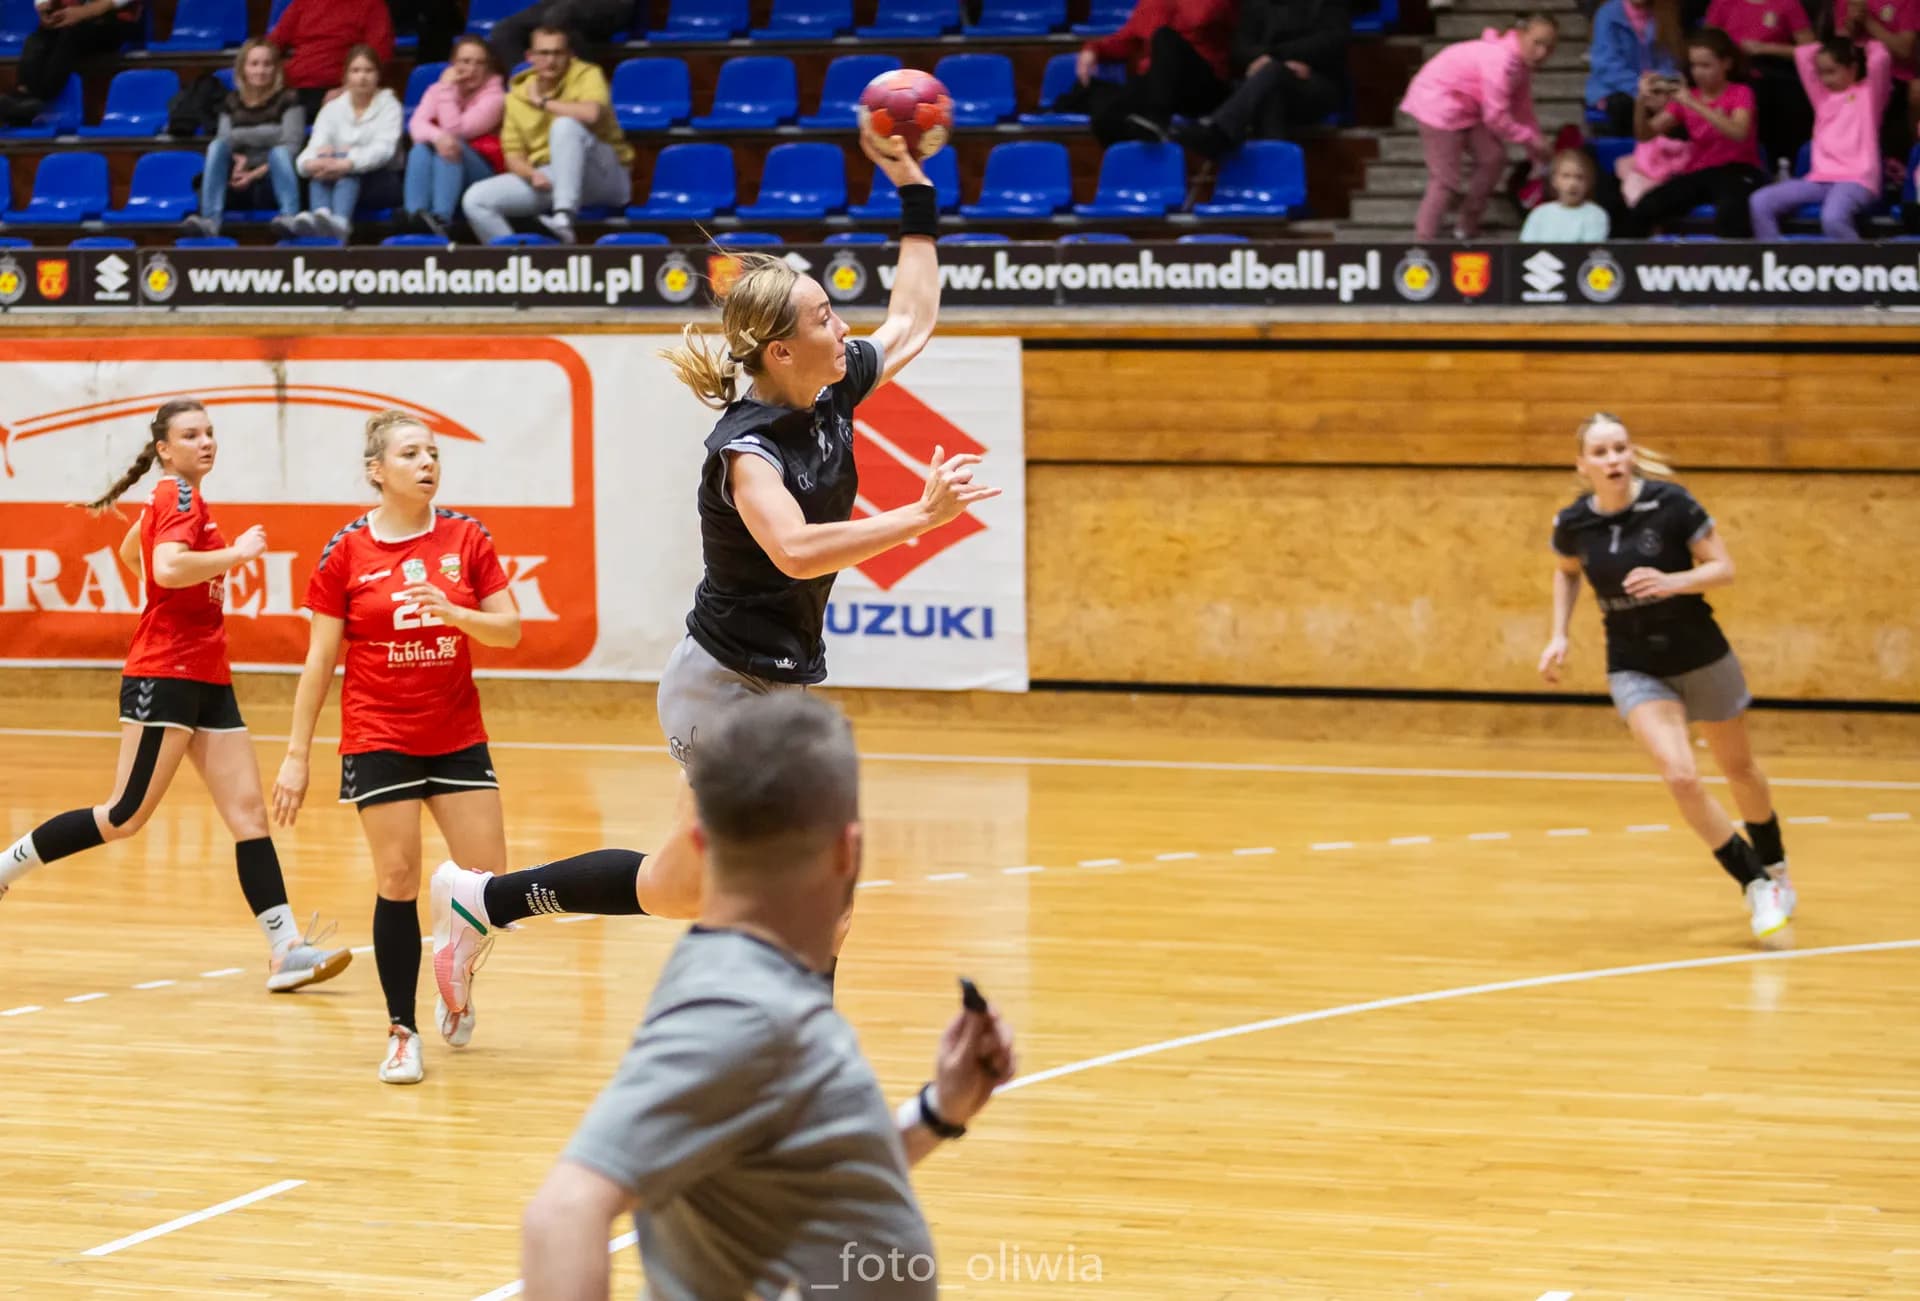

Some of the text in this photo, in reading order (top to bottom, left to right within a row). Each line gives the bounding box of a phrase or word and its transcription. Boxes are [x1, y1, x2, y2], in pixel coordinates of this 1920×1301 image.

[187, 255, 644, 304] www.koronahandball.pl
[1636, 251, 1920, 292] www.korona
[826, 602, 994, 639] UZUKI
